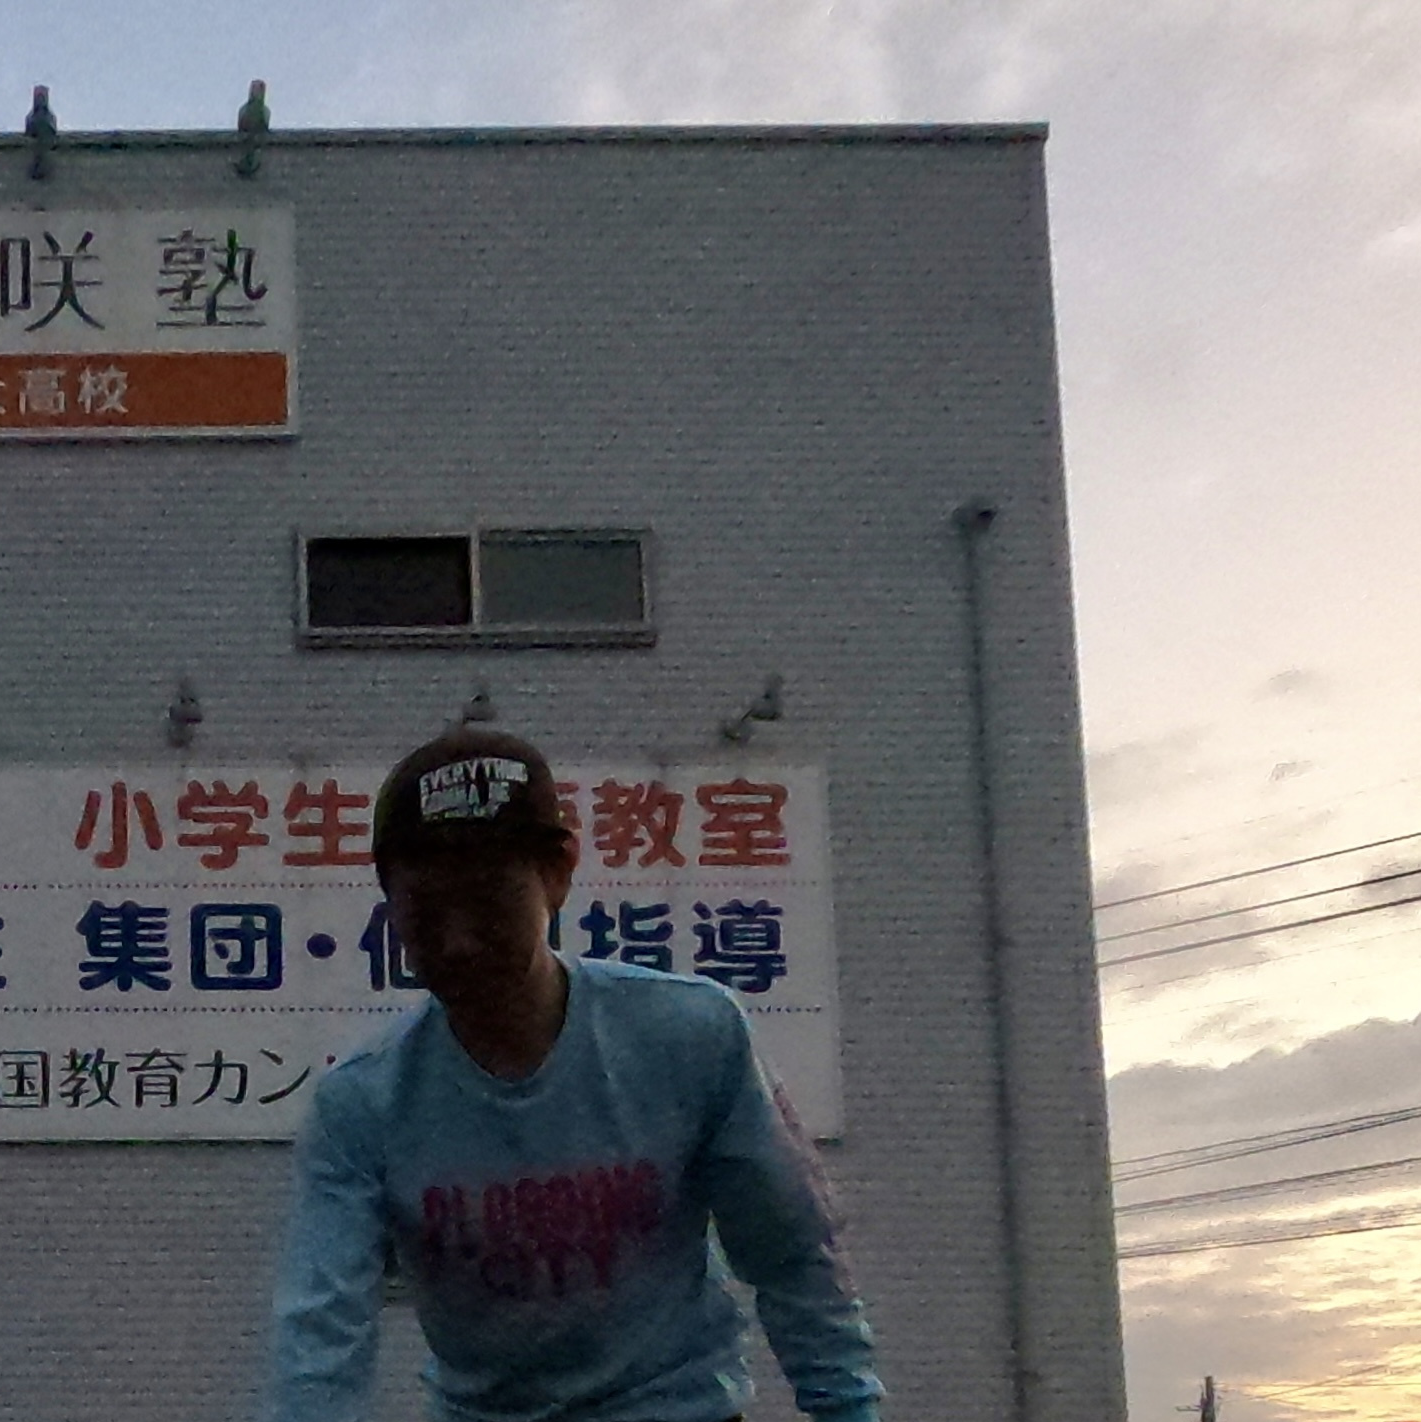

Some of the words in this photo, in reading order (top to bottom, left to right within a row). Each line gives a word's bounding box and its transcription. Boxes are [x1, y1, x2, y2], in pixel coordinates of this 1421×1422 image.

[0, 229, 268, 332] 咲塾
[73, 779, 792, 869] 小学生教室
[76, 897, 788, 994] 集団・指導
